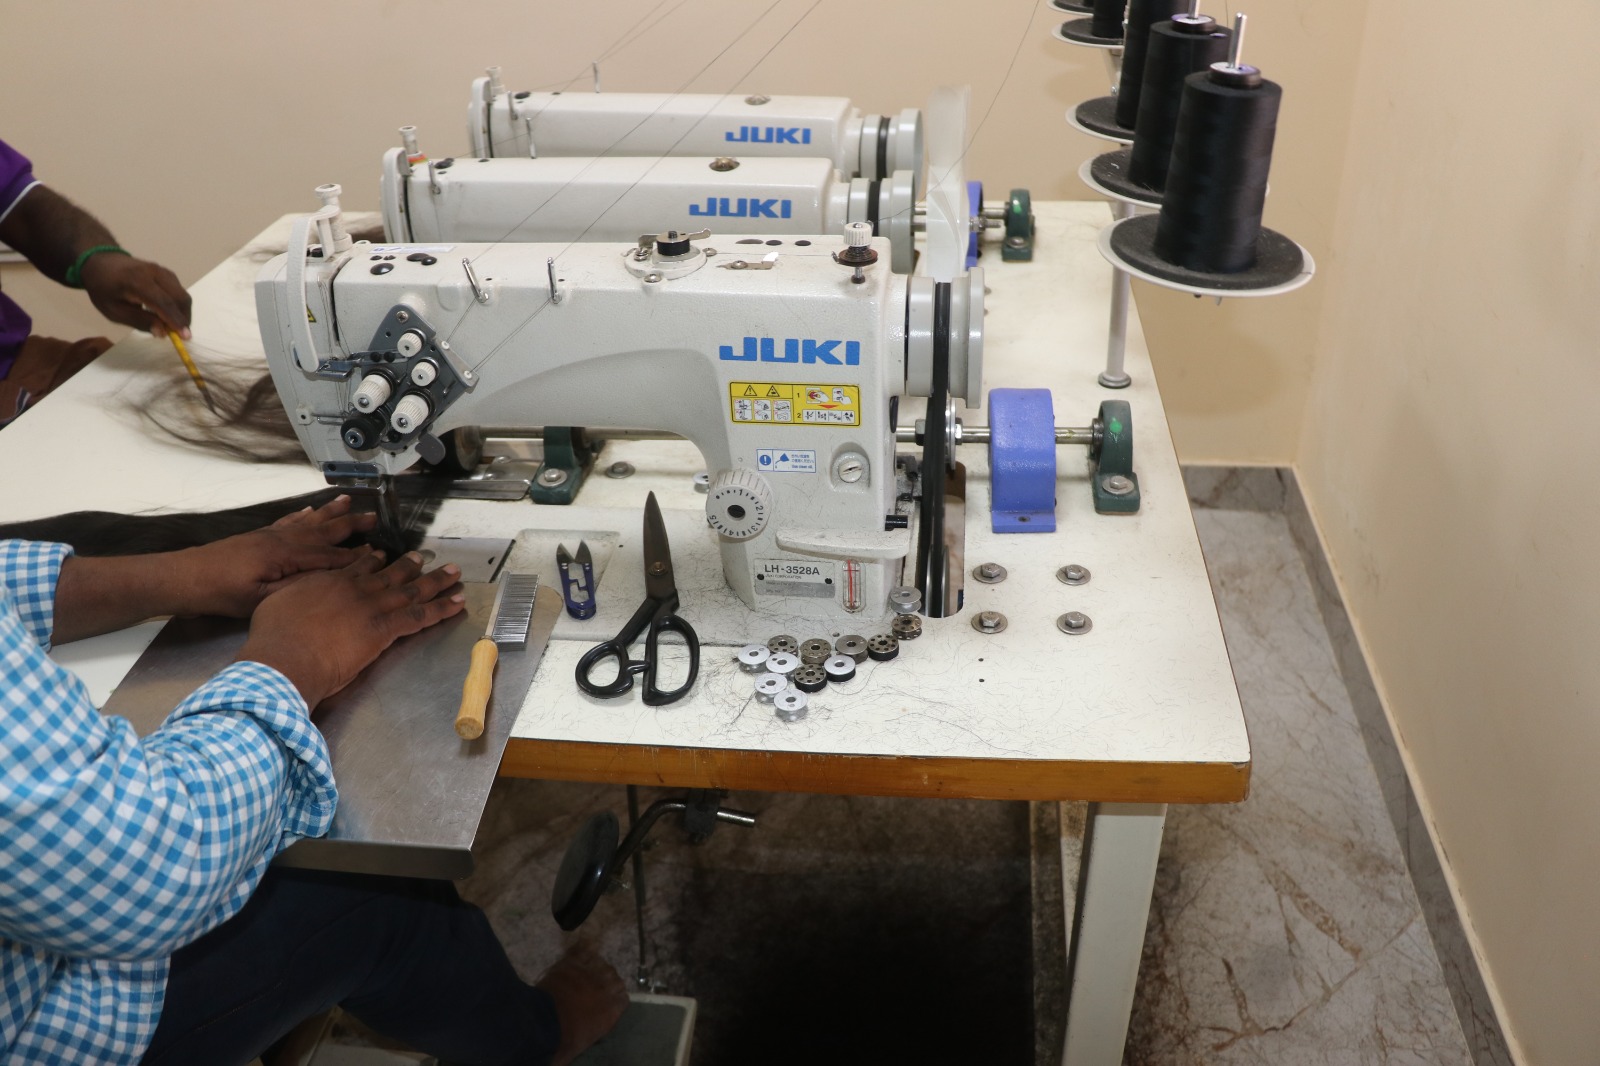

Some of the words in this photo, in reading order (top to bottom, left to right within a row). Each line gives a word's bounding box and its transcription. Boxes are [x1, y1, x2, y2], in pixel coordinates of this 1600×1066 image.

[726, 126, 811, 144] JUKI
[690, 198, 791, 218] JUKI
[719, 337, 860, 366] JUKI
